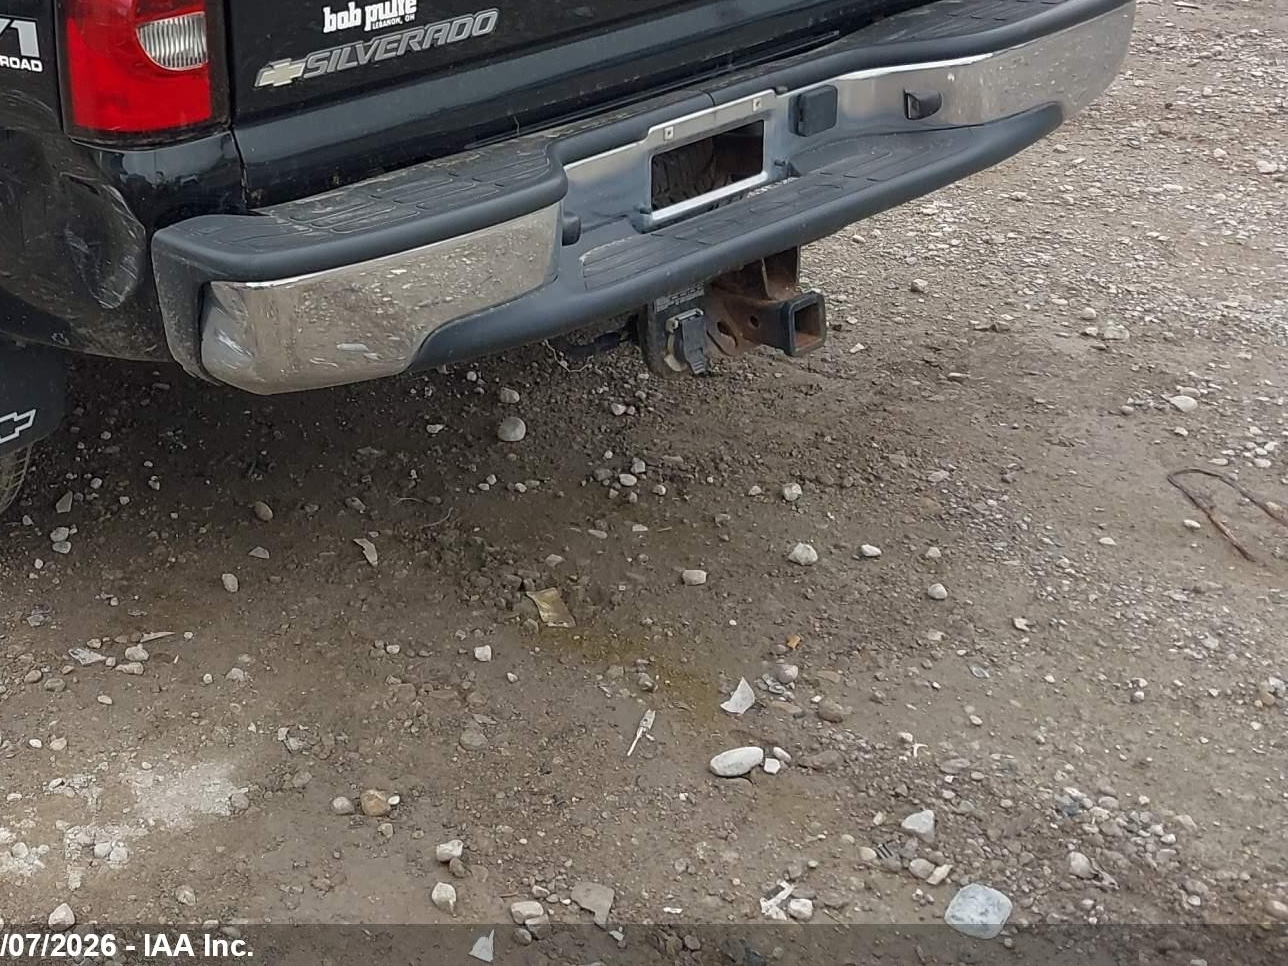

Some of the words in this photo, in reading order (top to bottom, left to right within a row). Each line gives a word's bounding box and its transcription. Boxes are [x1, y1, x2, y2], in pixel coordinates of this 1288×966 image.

[323, 2, 362, 33] bob
[302, 8, 499, 79] SILVERADO
[0, 55, 43, 72] ROAD
